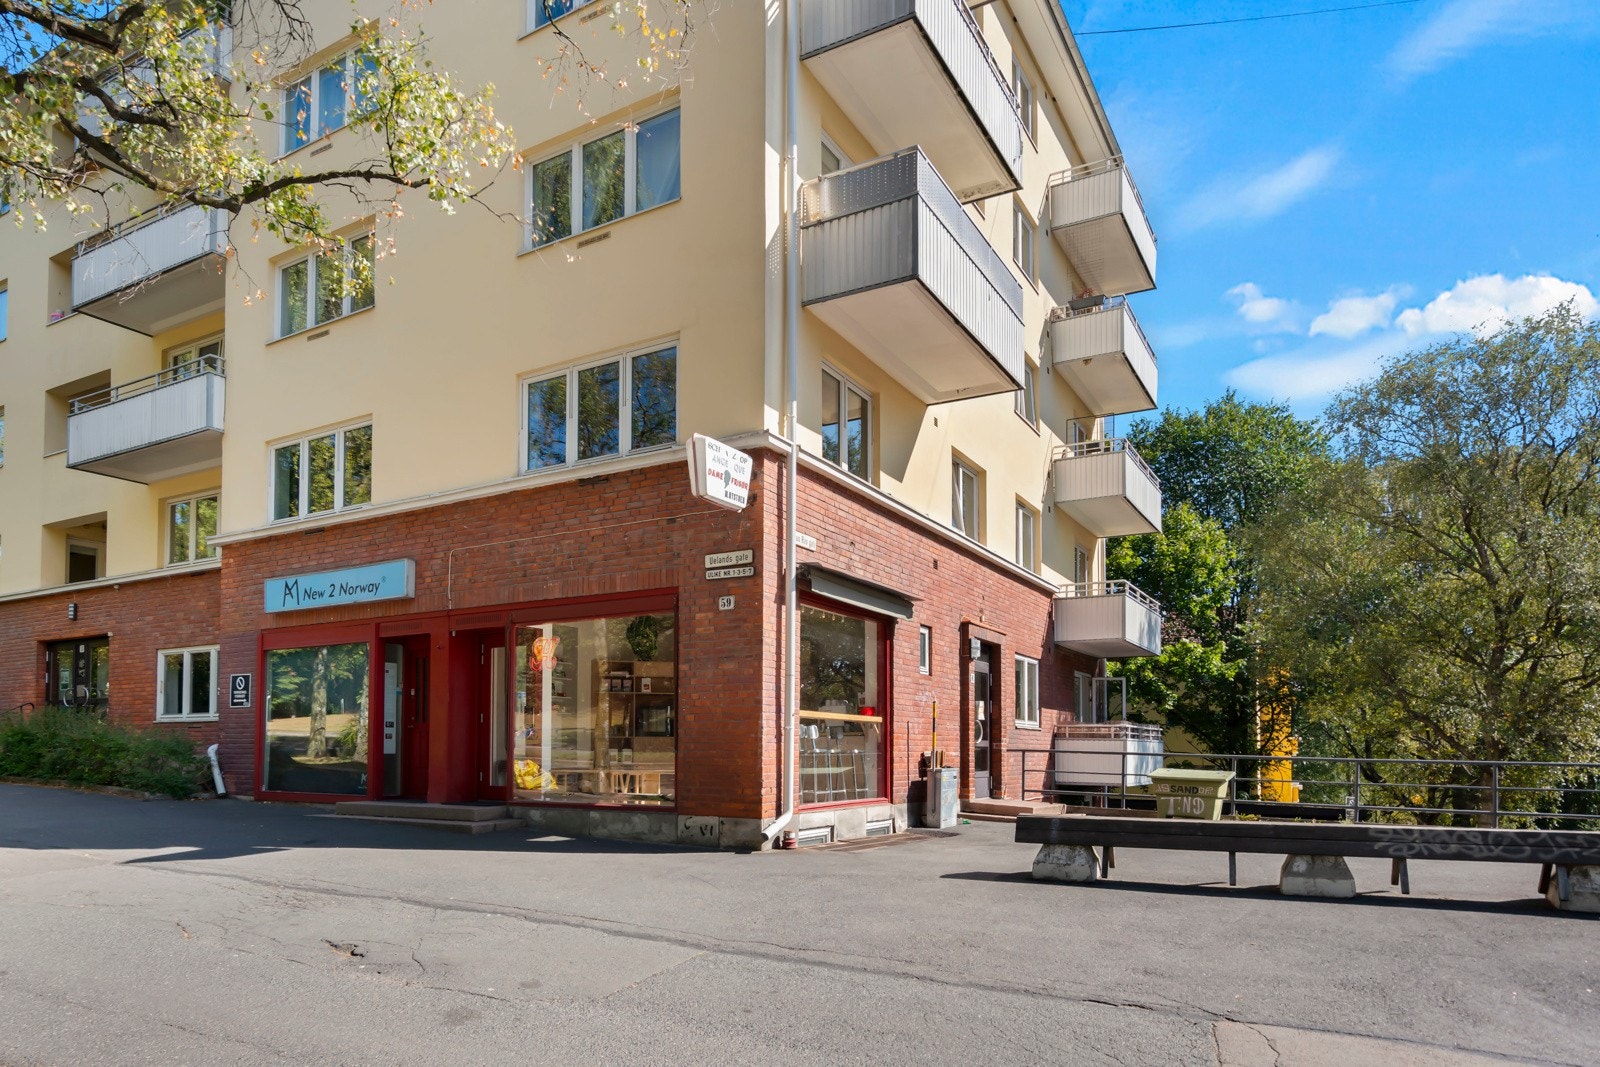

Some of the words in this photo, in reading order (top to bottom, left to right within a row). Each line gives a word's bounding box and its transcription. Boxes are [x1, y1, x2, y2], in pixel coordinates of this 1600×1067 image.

[708, 468, 723, 480] DAME
[709, 555, 732, 565] Uelands
[735, 553, 749, 563] gate
[303, 587, 325, 601] New
[328, 584, 336, 598] 2
[721, 598, 732, 608] 59
[1170, 785, 1199, 794] SAND
